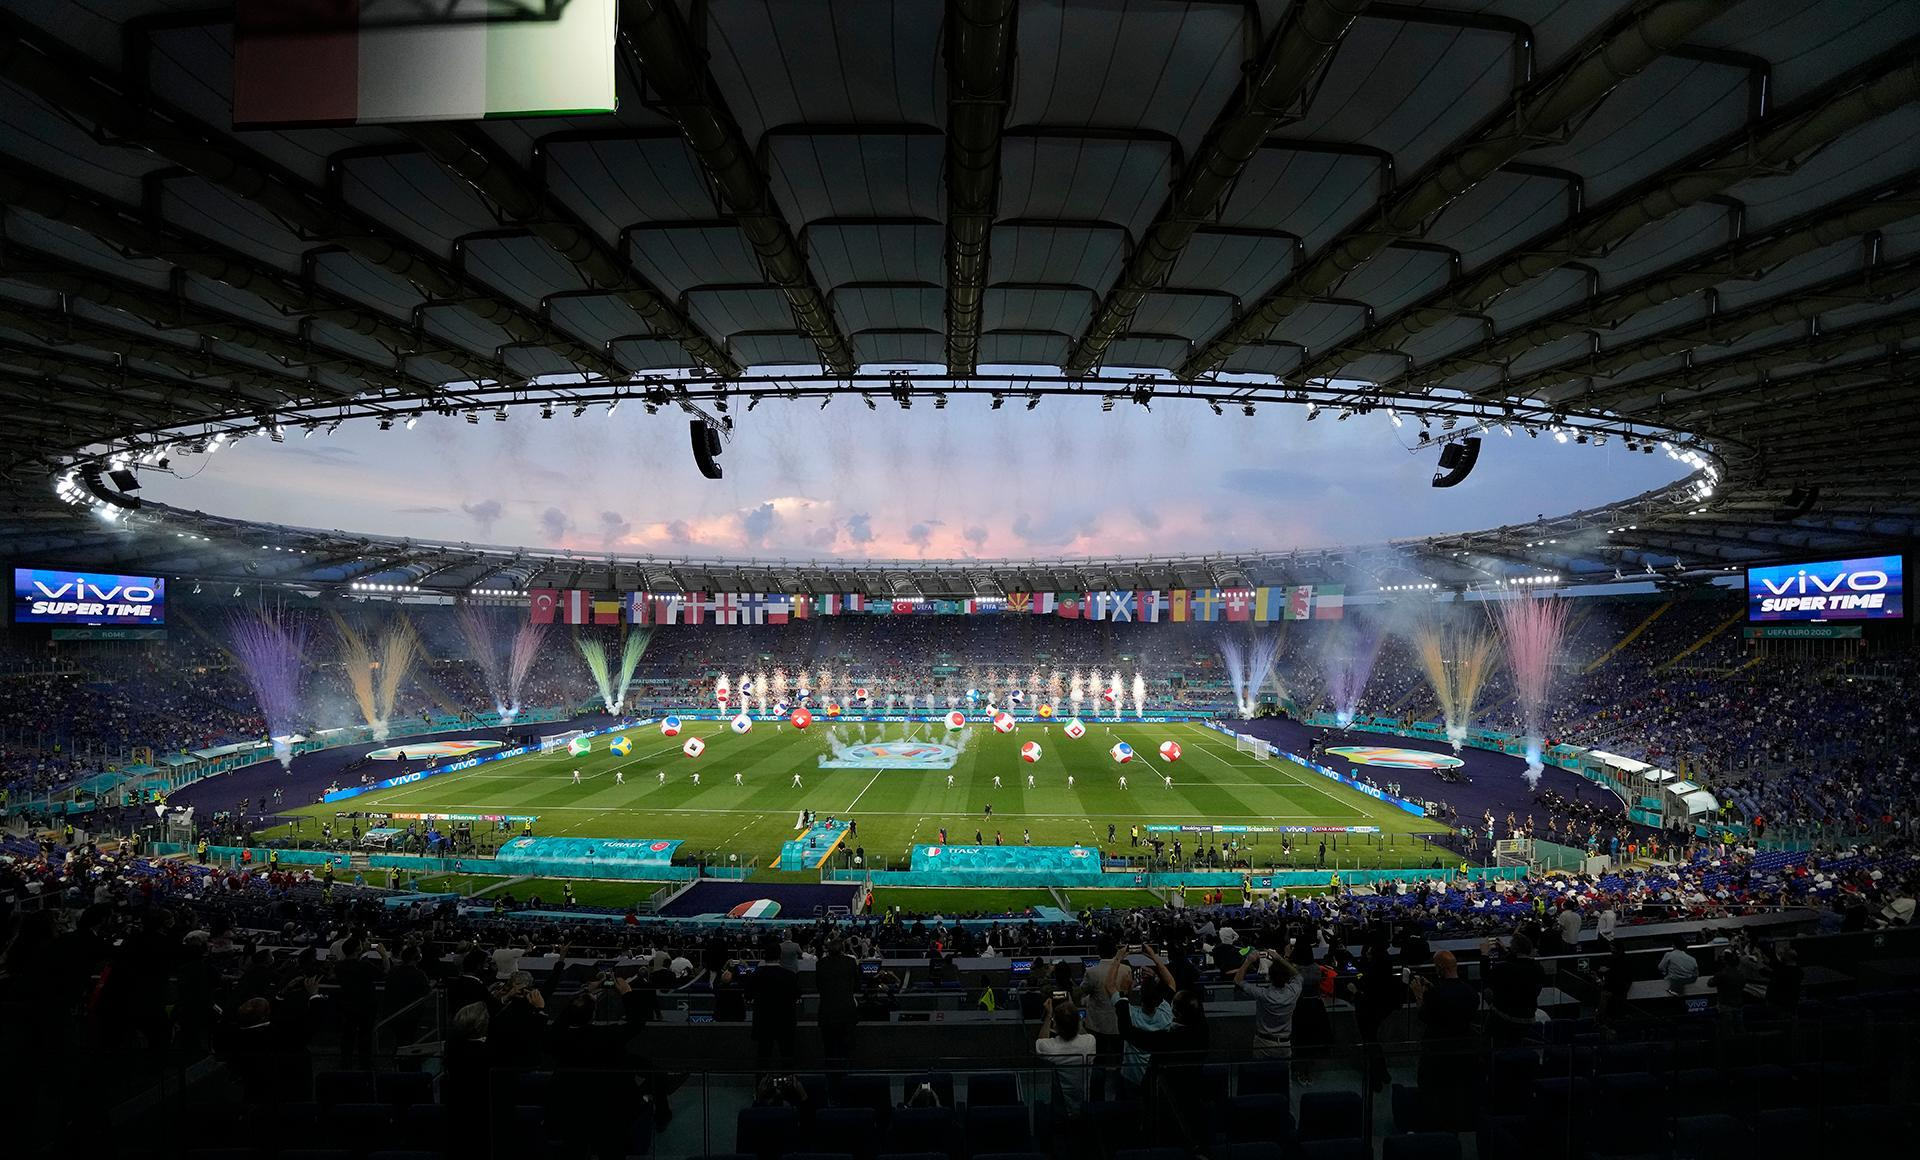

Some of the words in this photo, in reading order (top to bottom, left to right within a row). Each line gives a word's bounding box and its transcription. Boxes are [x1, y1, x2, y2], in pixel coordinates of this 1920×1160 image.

[33, 577, 154, 602] vivo
[1762, 570, 1888, 595] vivo
[31, 601, 104, 616] SUPER
[105, 603, 152, 617] TIME
[916, 603, 933, 611] UEFA
[1761, 596, 1826, 612] SUPER
[1829, 593, 1885, 610] TIME
[1788, 629, 1809, 637] EURO
[1811, 629, 1832, 637] 2020
